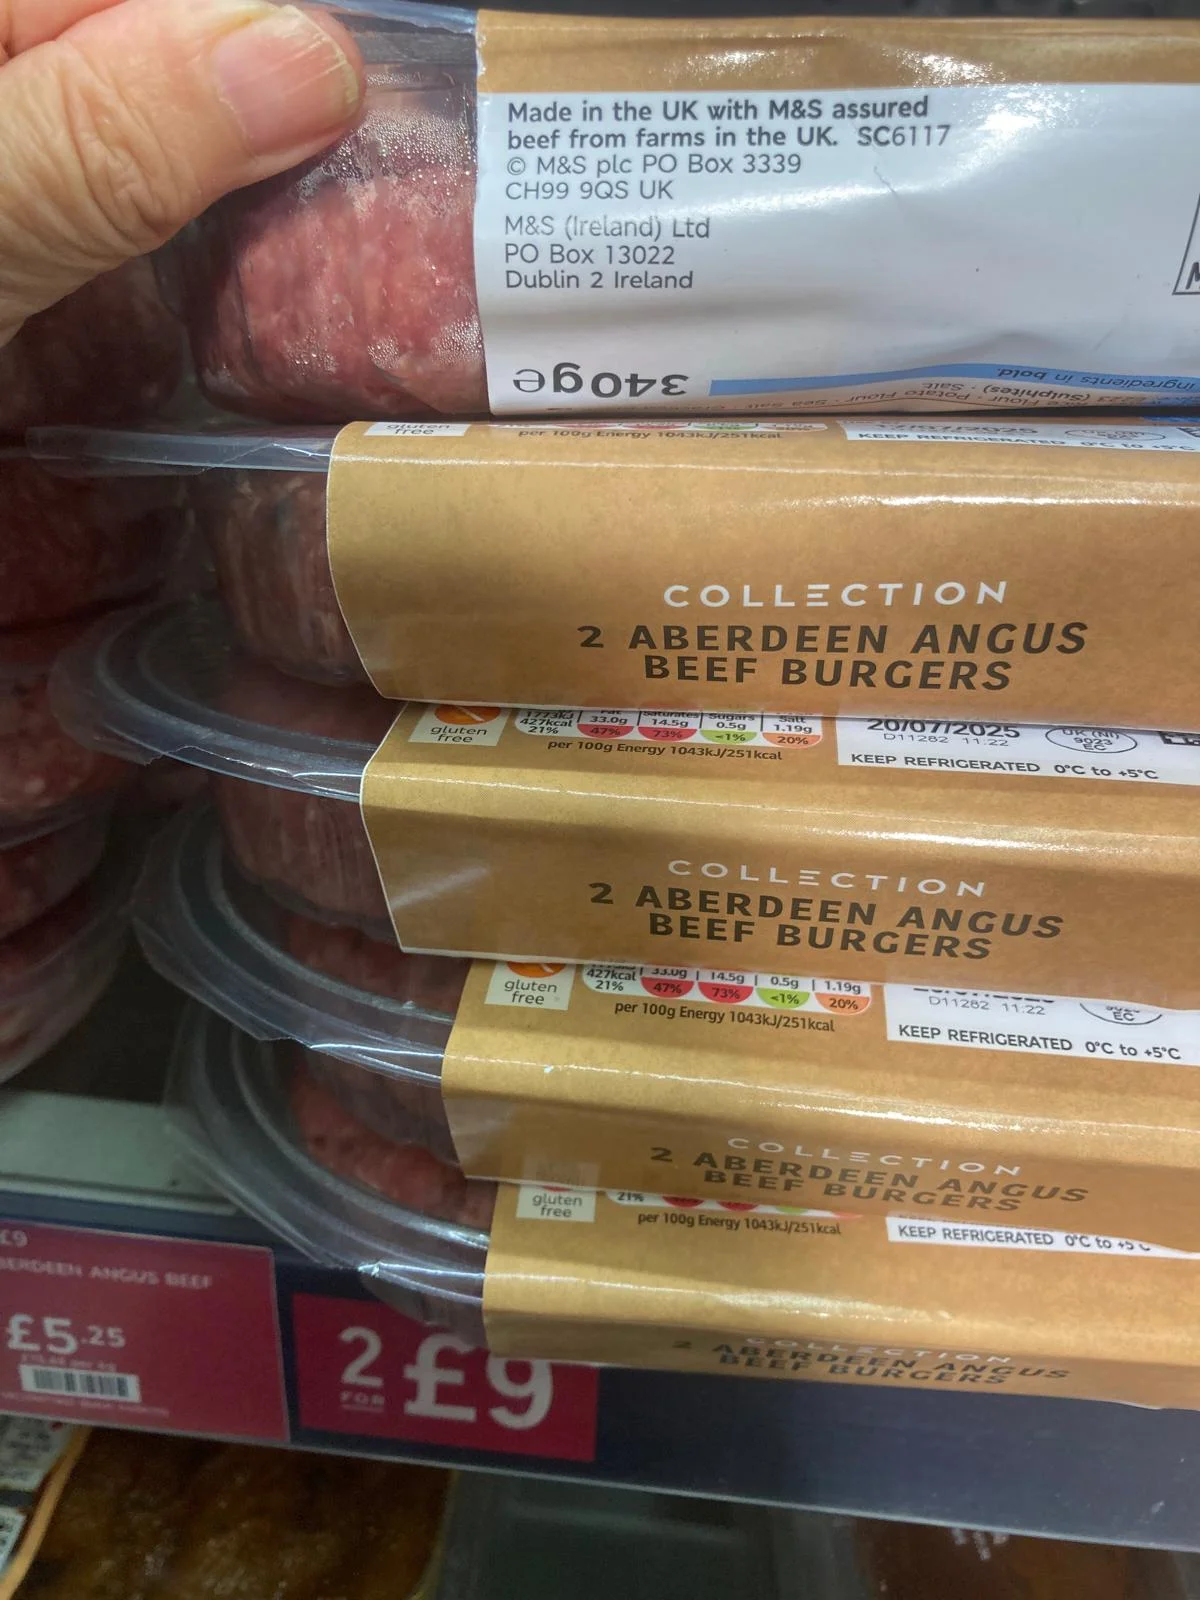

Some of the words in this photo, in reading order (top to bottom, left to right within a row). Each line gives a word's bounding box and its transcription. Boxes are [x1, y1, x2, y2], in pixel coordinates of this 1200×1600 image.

[508, 101, 573, 123] Made
[582, 100, 603, 122] in
[612, 101, 653, 122] the
[663, 101, 699, 121] UK
[707, 99, 759, 121] with
[769, 99, 823, 120] M&S
[832, 97, 929, 119] assured
[508, 129, 560, 149] beef
[570, 128, 626, 148] from
[636, 127, 705, 148] farms
[716, 127, 737, 147] in
[746, 127, 787, 147] the
[797, 127, 839, 147] UK.
[857, 124, 952, 147] SC6117
[537, 156, 587, 175] M&S
[597, 154, 633, 178] plc
[643, 154, 678, 174] PO
[688, 153, 734, 174] Box
[743, 153, 802, 174] 3339
[505, 181, 570, 201] CH99
[580, 181, 630, 201] 9QS
[640, 180, 674, 200] UK
[505, 216, 555, 236] M&S
[564, 214, 662, 241] (Ireland)
[672, 217, 711, 239] Ltd
[505, 244, 539, 265] PO
[550, 244, 595, 265] Box
[605, 245, 676, 265] 13022
[506, 270, 580, 290] Dublin
[590, 271, 604, 290] 2
[614, 270, 694, 290] Ireland
[1054, 374, 1074, 384] in
[983, 384, 1091, 402] (Sulphites)
[518, 430, 546, 438] per
[596, 431, 650, 441] Energy
[915, 434, 1067, 446] REFRIGERATED
[664, 581, 1008, 607] COLLECTION
[576, 625, 605, 649] 2
[628, 624, 889, 653] ABERDEEN
[910, 621, 1089, 654] ANGUS
[644, 655, 759, 683] BEEF
[780, 659, 1013, 691] BURGERS
[430, 725, 488, 736] gluten
[519, 718, 573, 728] 427kcal
[590, 715, 629, 726] 33.0g
[651, 718, 689, 728] 14.5g
[716, 721, 747, 731] 0.5g
[773, 724, 813, 734] 1.19g
[528, 725, 560, 735] 21%
[590, 727, 621, 737] 47%
[652, 730, 683, 740] 73%
[715, 733, 746, 743] <1%
[777, 736, 809, 746] 20%
[866, 718, 1022, 739] 20/07/2025
[437, 734, 473, 743] free
[883, 733, 950, 745] D11282
[964, 736, 1010, 748] 11:22
[1083, 743, 1108, 752] EC
[547, 741, 573, 751] per
[578, 741, 613, 754] 100g
[616, 743, 666, 756] Energy
[671, 746, 783, 762] 1043kJ/251kcal
[851, 753, 898, 765] KEEP
[904, 756, 1041, 774] REFRIGERATED
[1054, 764, 1086, 776] 0°C
[1091, 766, 1112, 778] to
[1118, 768, 1160, 780] +5°C
[668, 859, 986, 897] COLLECTION
[588, 882, 615, 905] 2
[634, 885, 878, 926] ABERDEEN
[896, 905, 1065, 939] ANGUS
[648, 913, 756, 943] BEEF
[776, 923, 993, 961] BURGERS
[504, 979, 558, 993] gluten
[586, 969, 637, 982] 427kcal
[710, 972, 746, 985] 14.5g
[770, 976, 800, 989] 0.5g
[824, 981, 862, 995] 1.19g
[511, 992, 545, 1005] free
[595, 980, 625, 992] 21%
[652, 982, 683, 994] 47%
[711, 987, 741, 1000] 73%
[770, 993, 800, 1005] <1%
[829, 998, 860, 1011] 20%
[614, 1001, 638, 1015] per
[643, 1002, 677, 1020] 100g
[679, 1006, 726, 1024] Energy
[730, 1011, 836, 1033] 1043kJ/251kcal
[928, 995, 991, 1011] D11282
[1002, 1002, 1047, 1016] 11:22
[1113, 1011, 1136, 1022] EC
[899, 1024, 942, 1040] KEEP
[947, 1029, 1074, 1052] REFRIGERATED
[1084, 1041, 1115, 1056] 0°C
[1120, 1043, 1139, 1057] to
[1144, 1046, 1183, 1061] +5°C
[726, 1137, 1022, 1177] COLLECTION
[650, 1146, 674, 1163] 2
[693, 1152, 920, 1190] ABERDEEN
[936, 1177, 1091, 1203] ANGUS
[531, 1191, 584, 1207] gluten
[703, 1169, 805, 1193] BEEF
[823, 1183, 1022, 1213] BURGERS
[540, 1204, 573, 1219] free
[637, 1212, 659, 1225] per
[664, 1212, 696, 1228] 100g
[698, 1215, 741, 1232] Energy
[743, 1217, 842, 1236] 1043kJ/251kcal
[898, 1225, 937, 1239] KEEP
[942, 1227, 1055, 1246] REFRIGERATED
[1064, 1234, 1092, 1248] 0°C
[1096, 1237, 1113, 1250] to
[90, 1266, 160, 1285] ANGUS
[164, 1273, 213, 1290] BEEF
[6, 1314, 127, 1355] £5.25
[712, 1343, 919, 1369] ABERDEEN
[933, 1362, 1072, 1380] ANGUS
[744, 1337, 1012, 1364] COLLECTION
[339, 1326, 384, 1388] 2
[403, 1332, 554, 1430] £9
[719, 1352, 812, 1372] BEEF
[829, 1362, 1007, 1385] BURGERS
